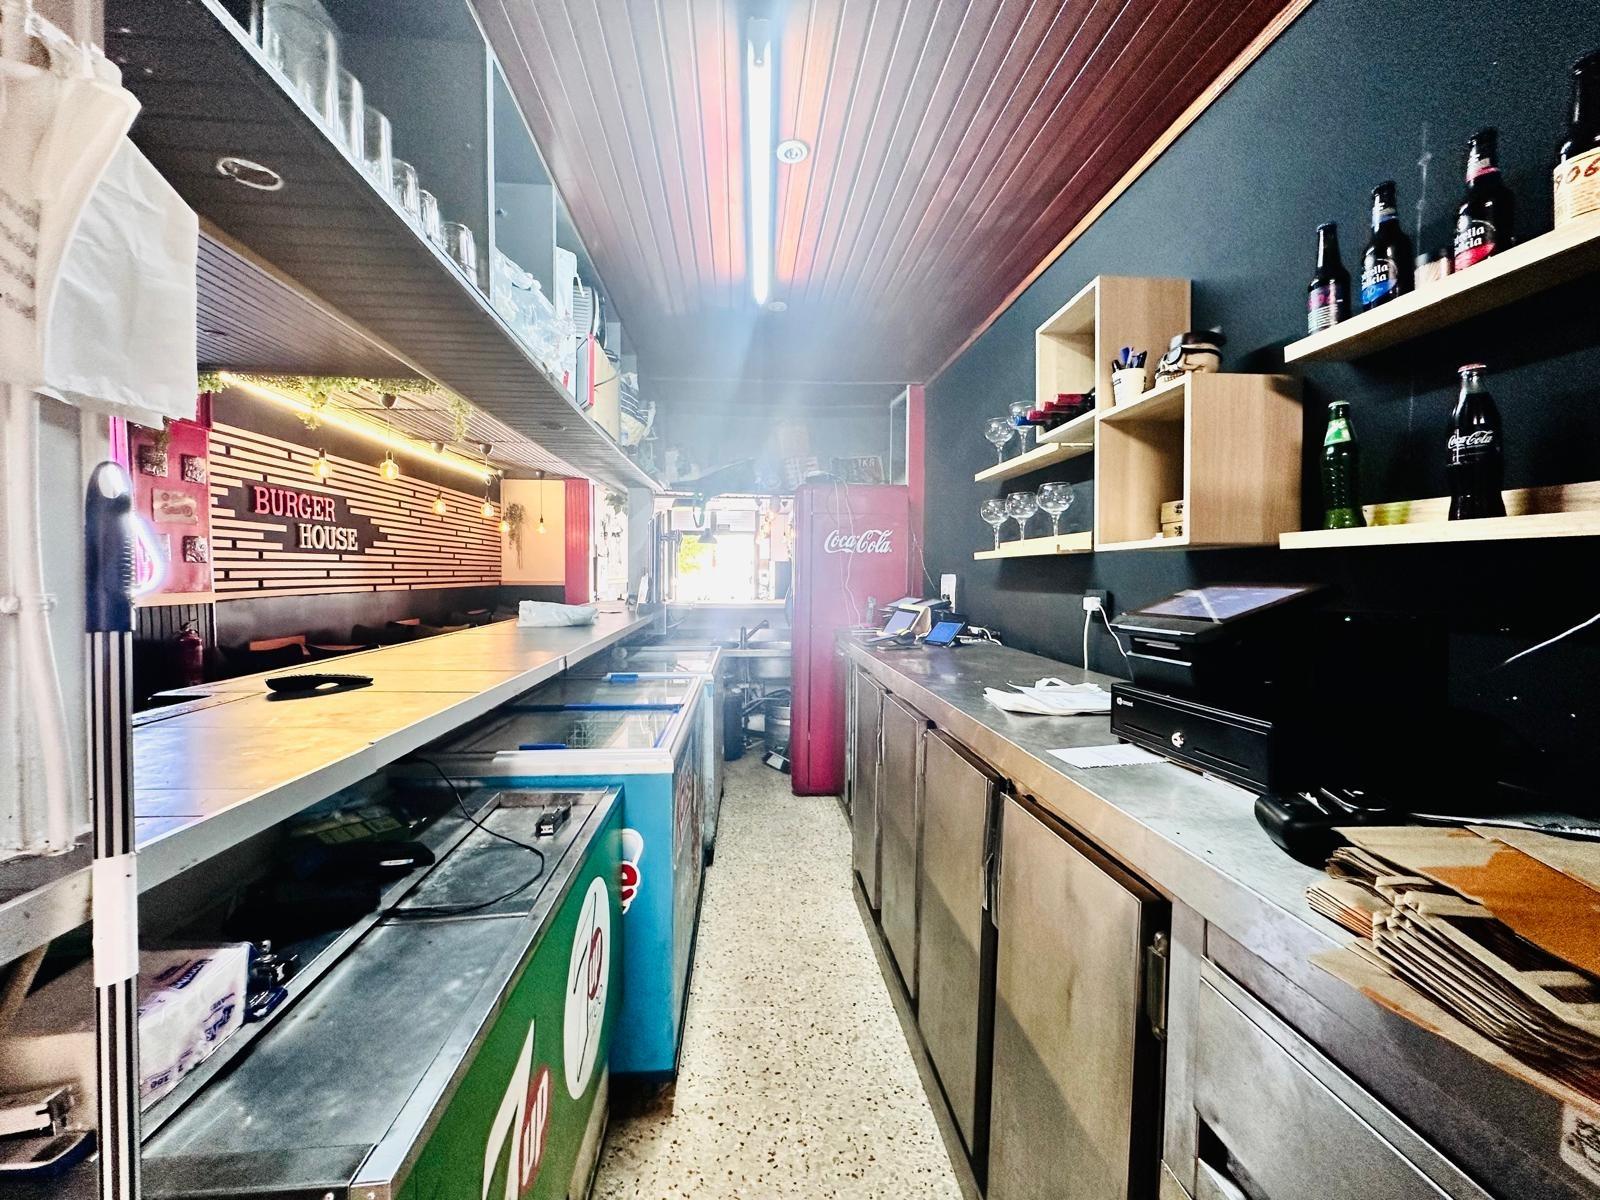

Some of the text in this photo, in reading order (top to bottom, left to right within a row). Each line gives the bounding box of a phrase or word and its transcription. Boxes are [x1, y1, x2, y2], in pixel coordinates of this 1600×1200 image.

[1448, 430, 1494, 449] Coca-Cola
[254, 486, 336, 522] BURGER
[299, 523, 358, 551] HOUSE
[824, 529, 893, 554] Coca-Cola
